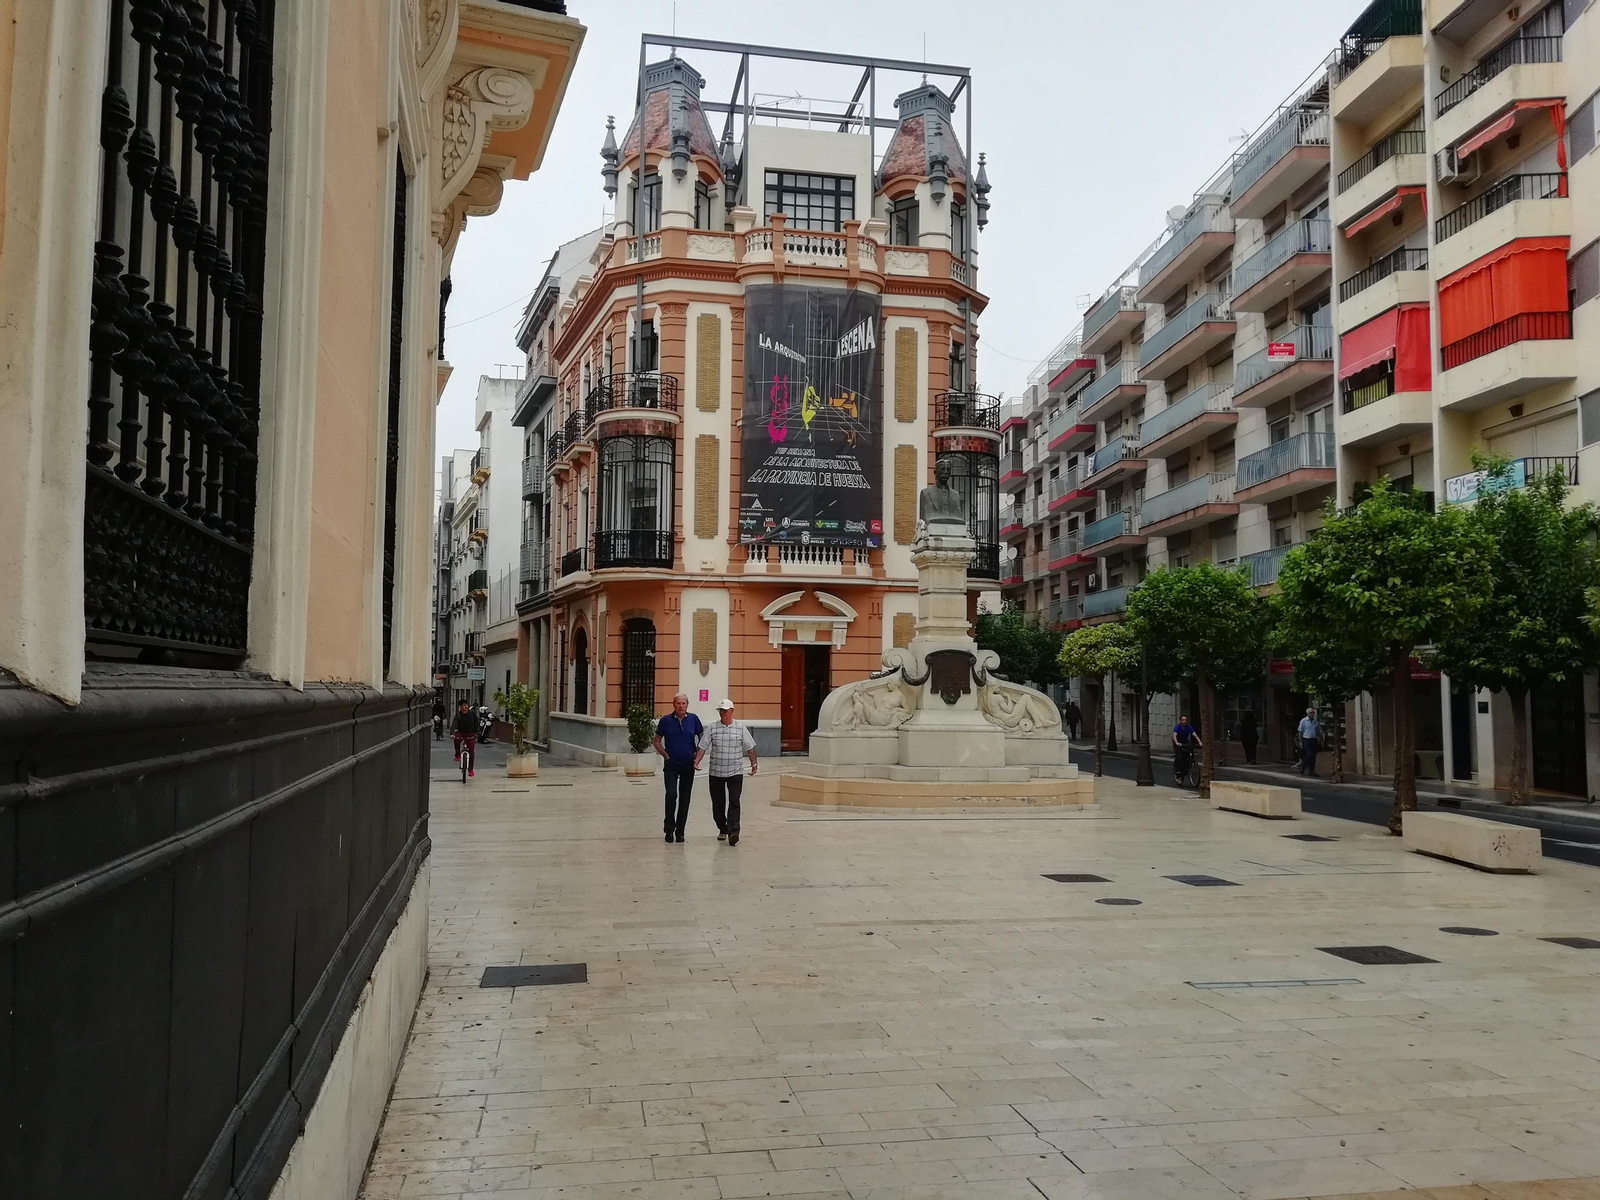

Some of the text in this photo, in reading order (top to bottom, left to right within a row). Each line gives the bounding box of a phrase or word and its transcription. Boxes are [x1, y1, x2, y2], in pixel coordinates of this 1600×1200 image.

[759, 333, 772, 349] LA
[841, 315, 876, 356] ESCENA
[786, 448, 816, 456] SEMANA
[763, 456, 862, 471] DE LA ARQUITECTURA DE
[748, 469, 871, 489] LA PROVINCIA DE HUELVA
